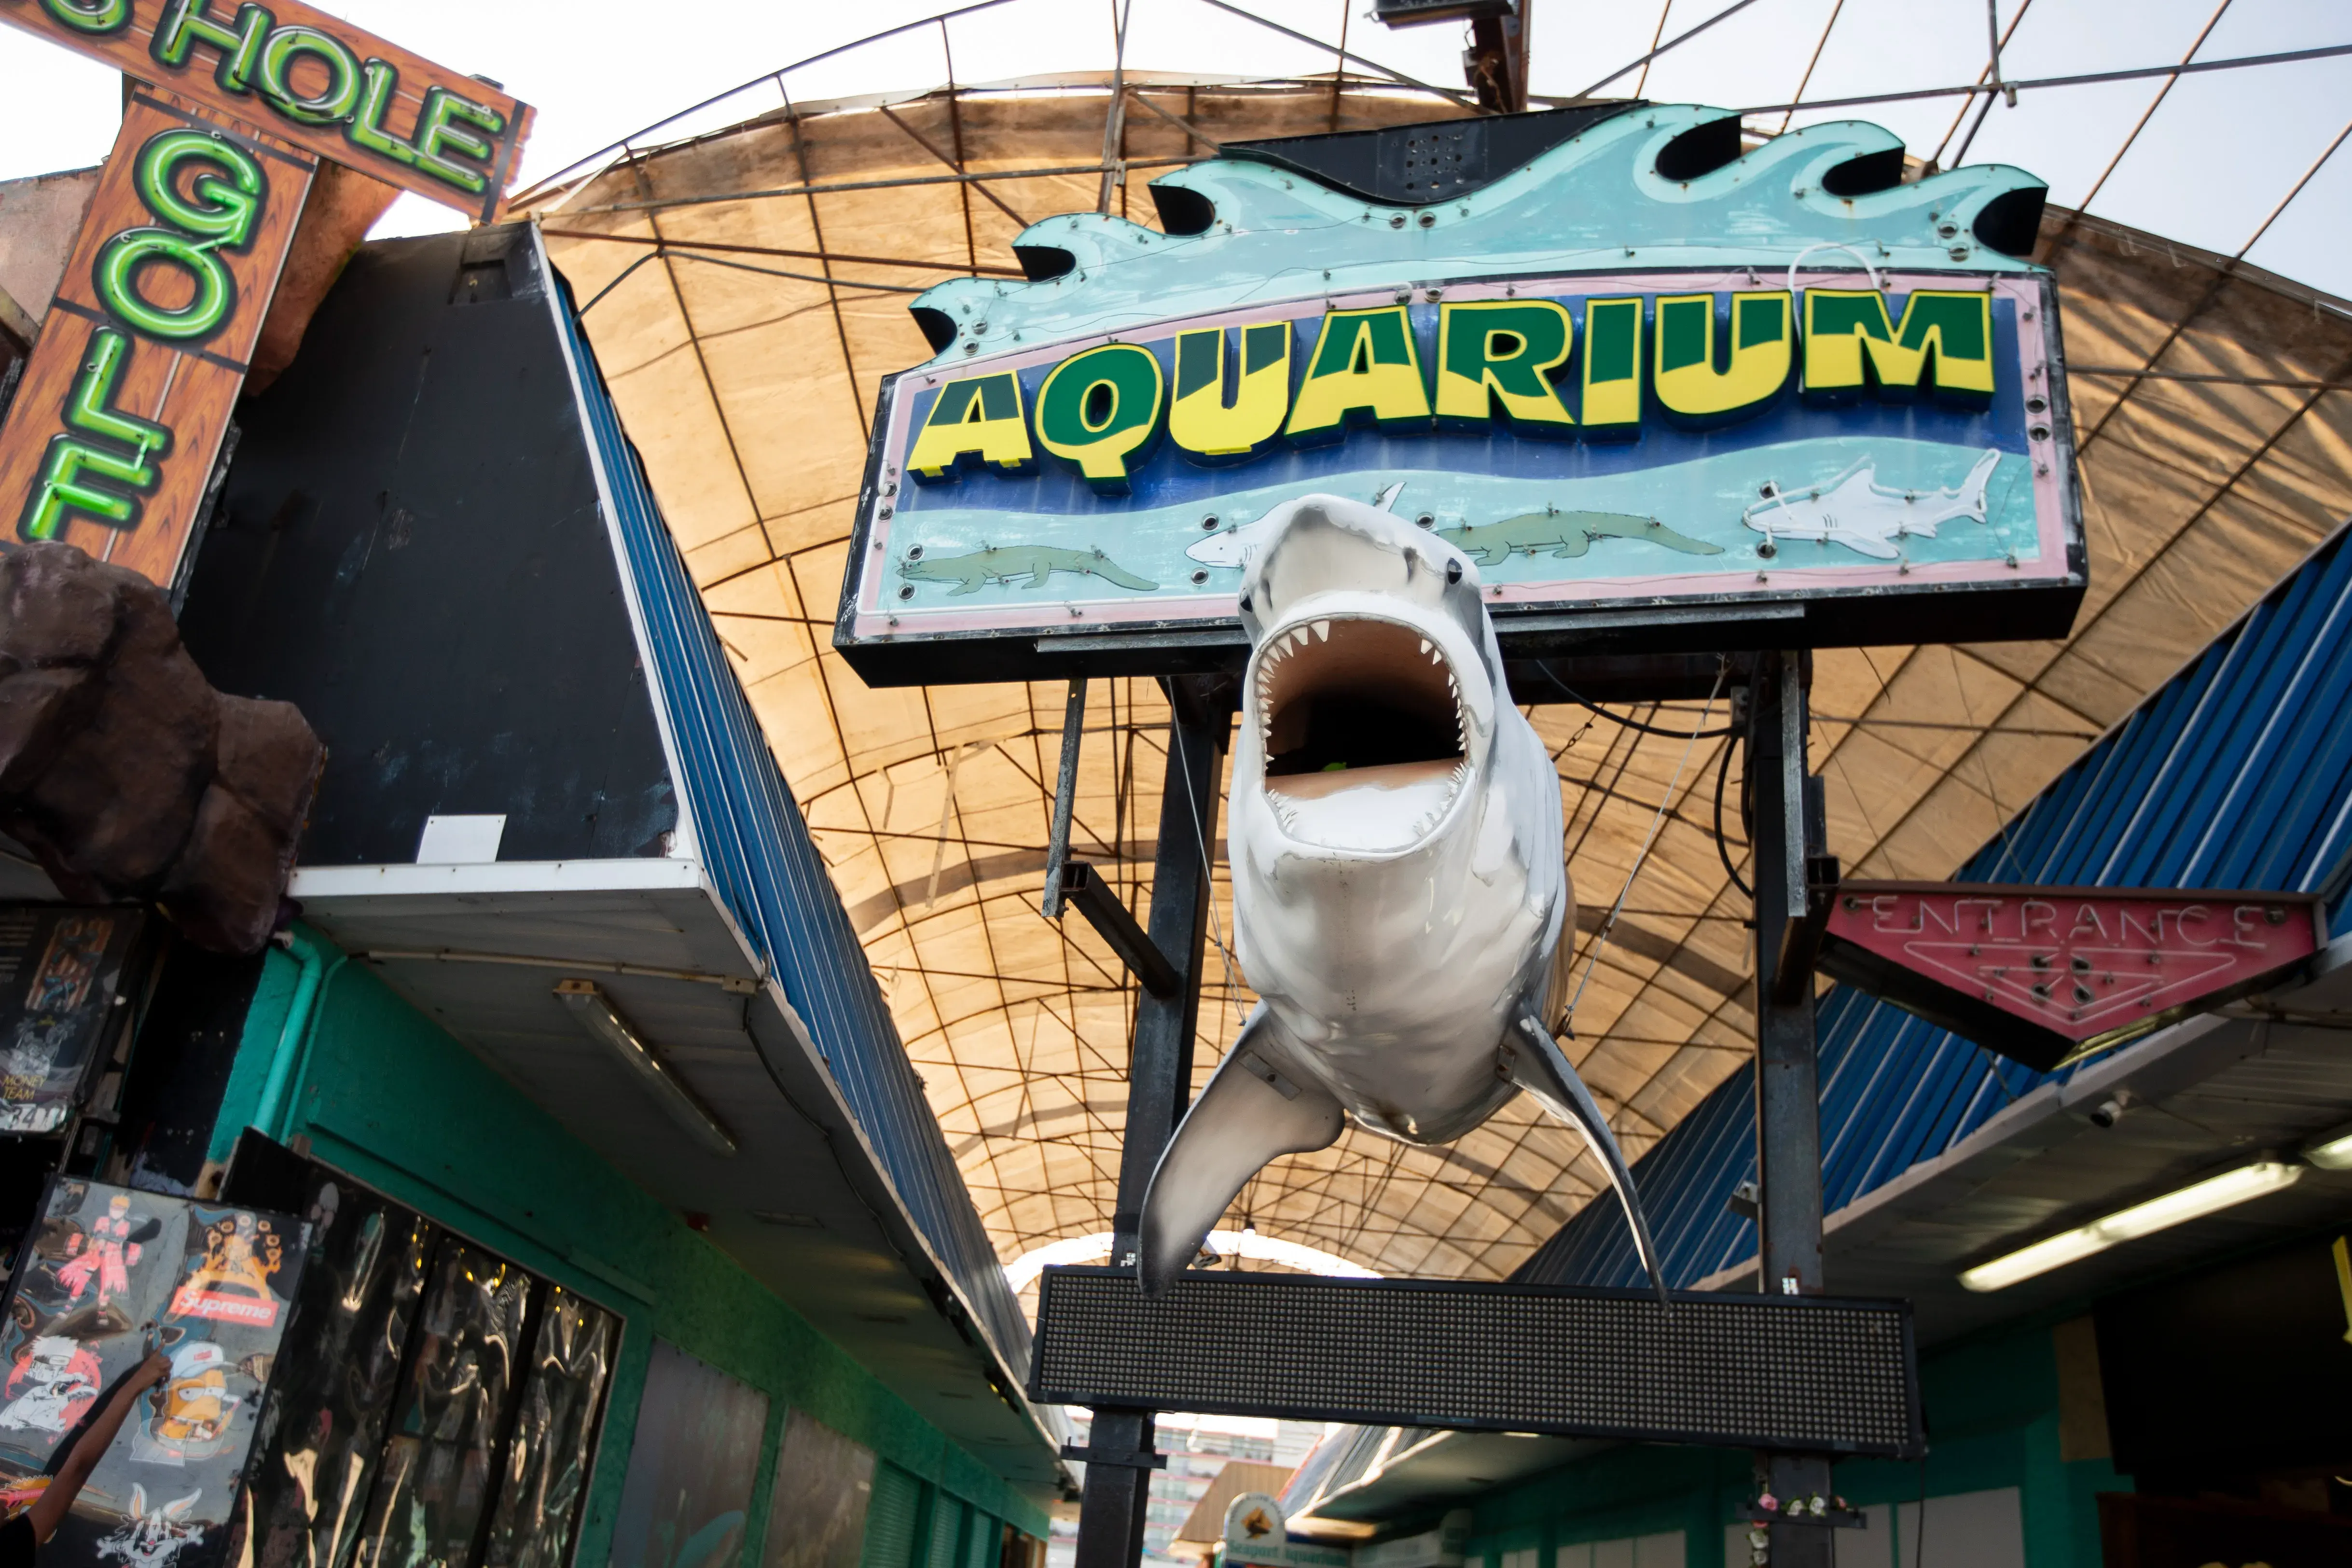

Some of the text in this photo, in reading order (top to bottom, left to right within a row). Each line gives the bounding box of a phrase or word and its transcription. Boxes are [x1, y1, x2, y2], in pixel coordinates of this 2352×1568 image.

[152, 0, 505, 194] HOLE
[22, 130, 266, 541] GOLF
[906, 289, 1996, 483] AQUARIUM
[1872, 894, 2268, 950] ENTRANCE
[3, 1086, 36, 1100] TEAM
[180, 1290, 272, 1320] Supreme
